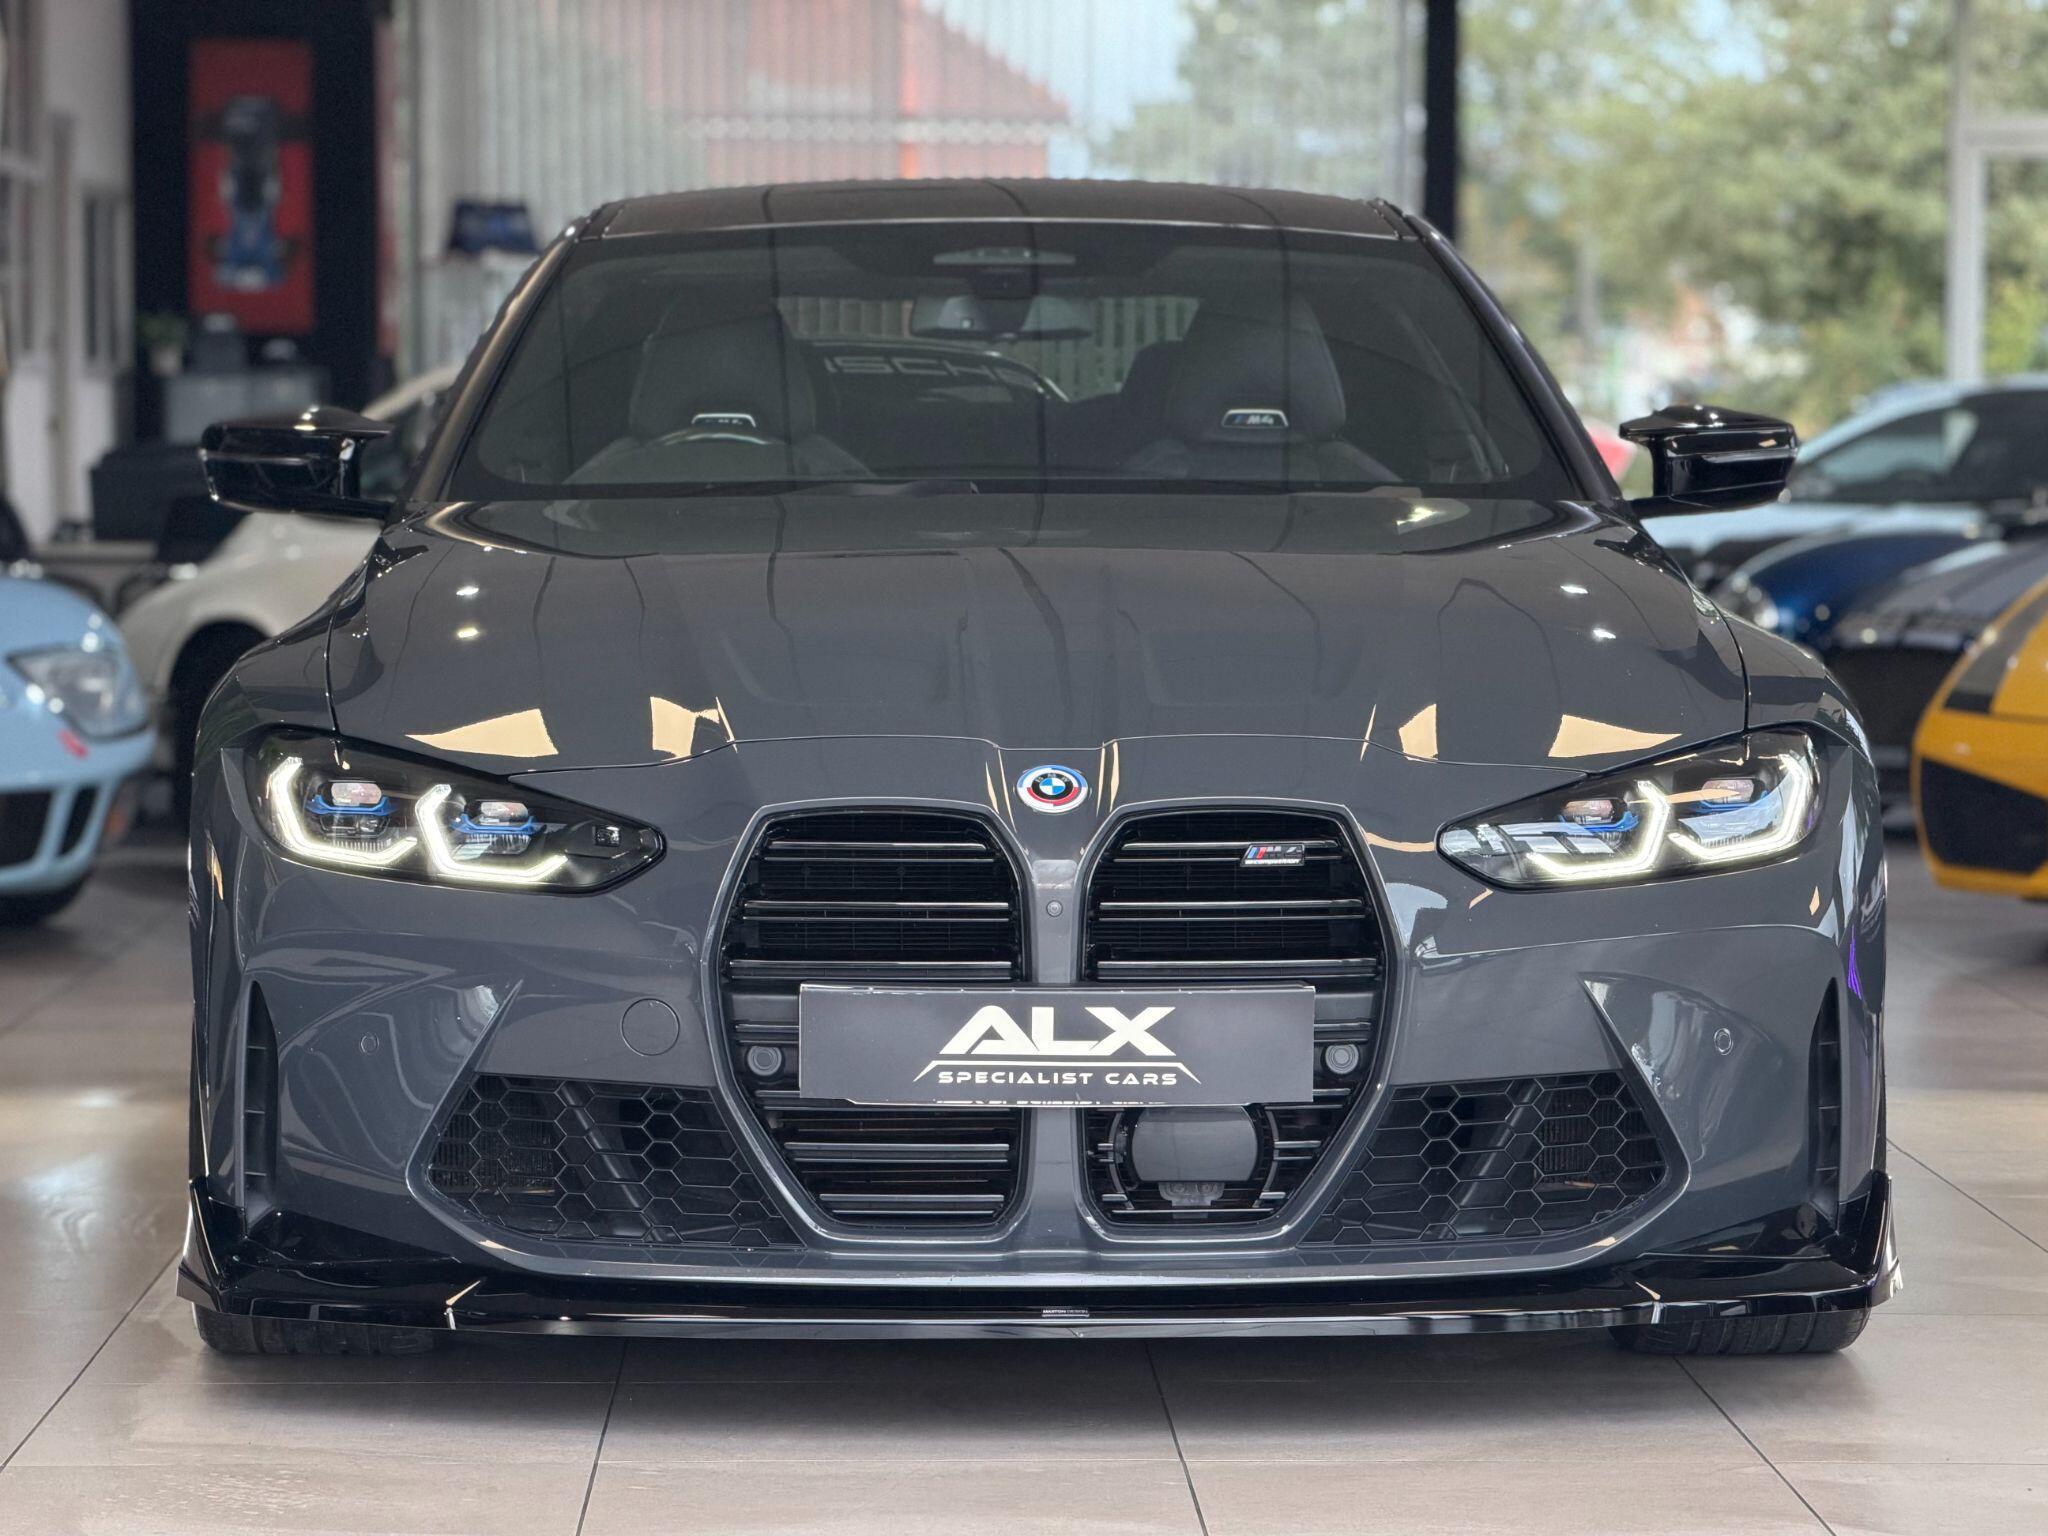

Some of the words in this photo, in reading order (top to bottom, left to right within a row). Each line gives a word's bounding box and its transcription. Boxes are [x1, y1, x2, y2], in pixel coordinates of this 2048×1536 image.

[939, 1005, 1177, 1056] ALX
[938, 1071, 1093, 1085] SPECIALIST
[1105, 1072, 1178, 1086] CARS
